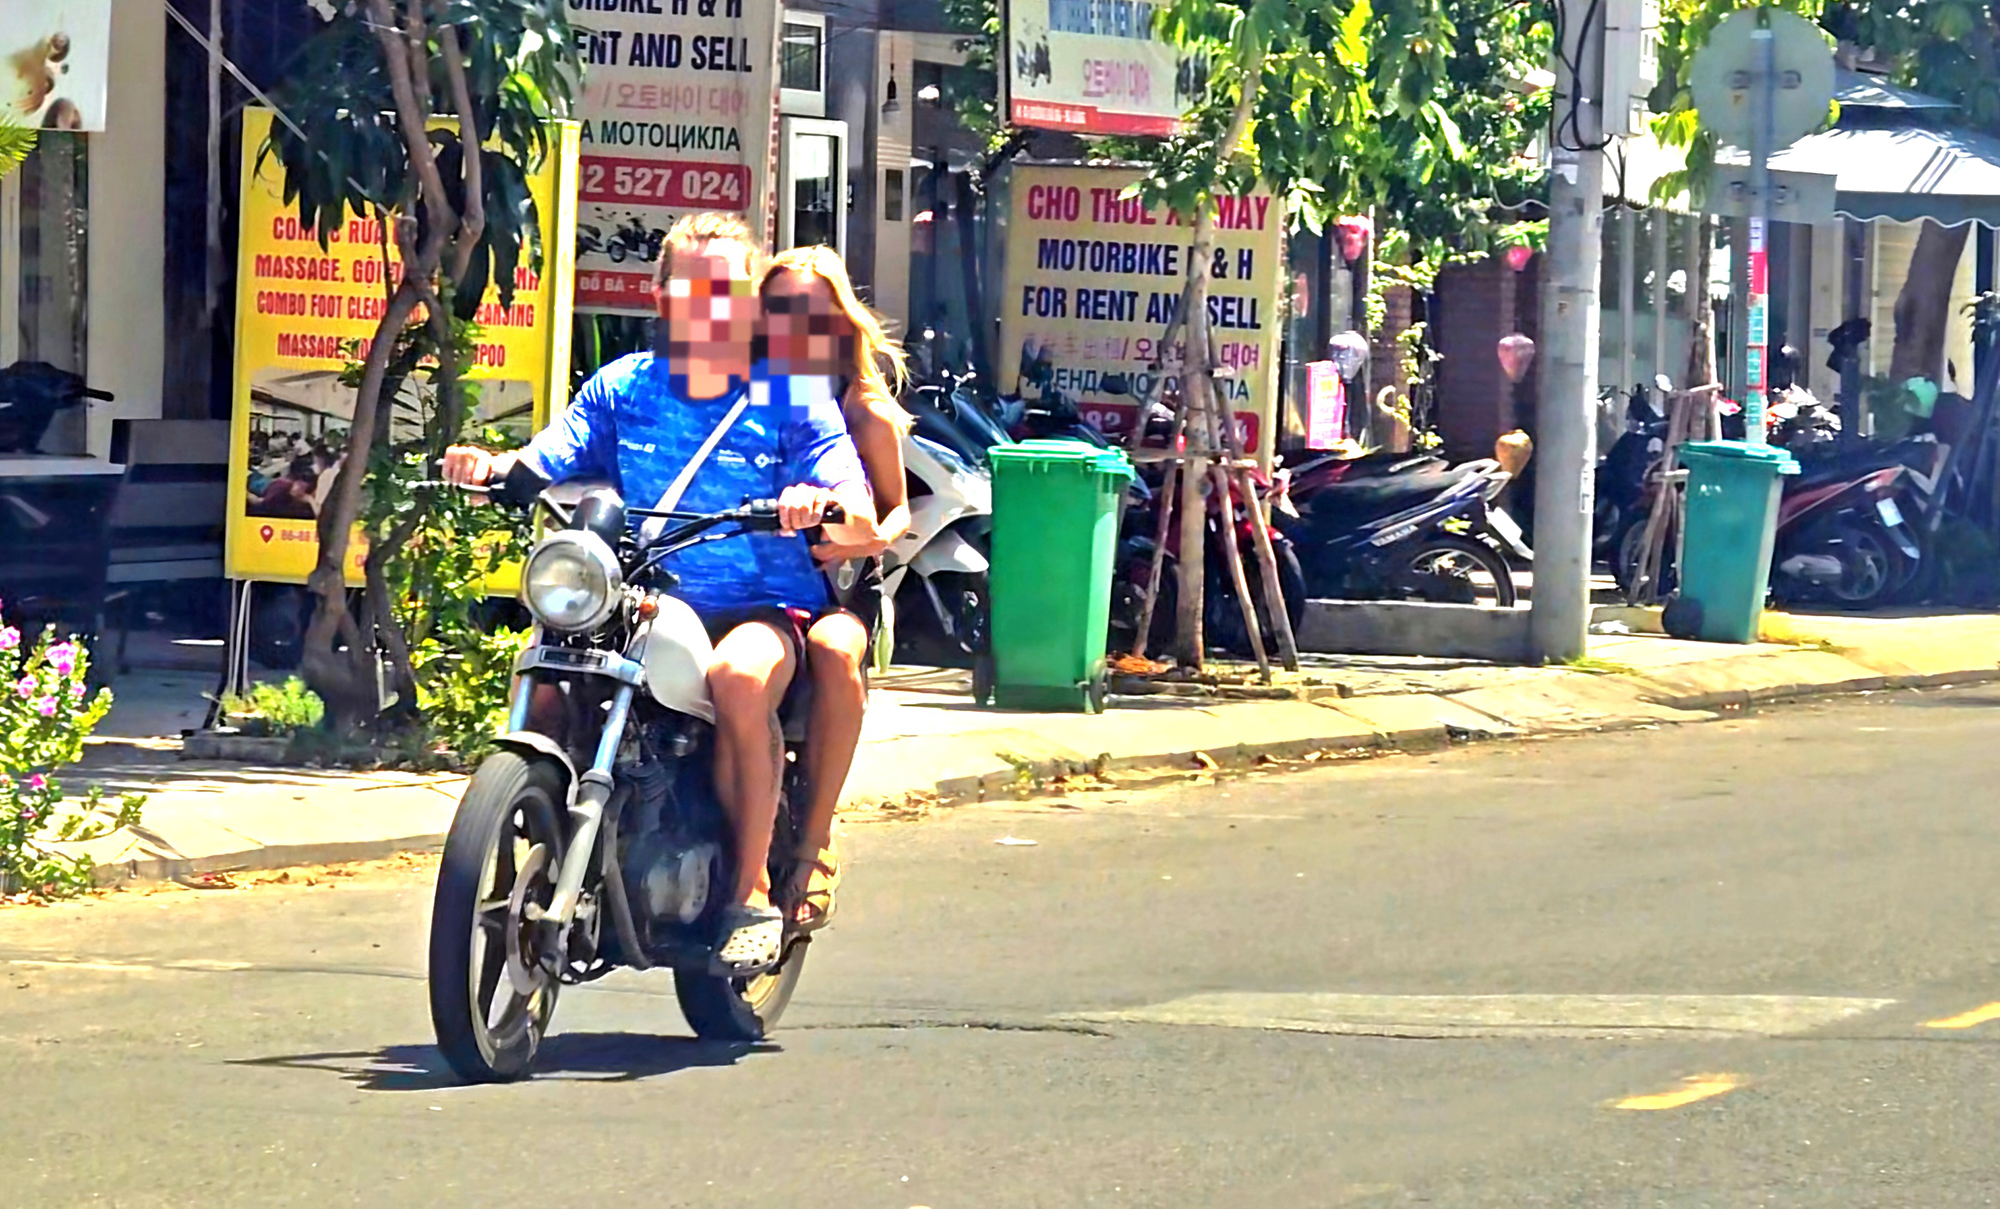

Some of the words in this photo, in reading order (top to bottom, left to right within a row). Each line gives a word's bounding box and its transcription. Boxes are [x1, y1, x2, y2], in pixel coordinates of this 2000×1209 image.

[560, 30, 622, 66] ENT
[628, 32, 682, 68] AND
[691, 35, 753, 72] SELL
[601, 119, 741, 153] МОТОЦИКЛА
[614, 165, 672, 197] 527
[682, 169, 741, 201] 024
[1027, 184, 1081, 222] CHO
[1037, 238, 1179, 276] MOTORBIKE
[1211, 247, 1229, 280] &
[1237, 248, 1254, 280] H
[256, 290, 306, 317] COMBO
[311, 294, 343, 319] FOOT
[1022, 285, 1068, 318] FOR
[1075, 288, 1139, 322] RENT
[1145, 292, 1184, 325] AN
[1206, 295, 1262, 329] SELL
